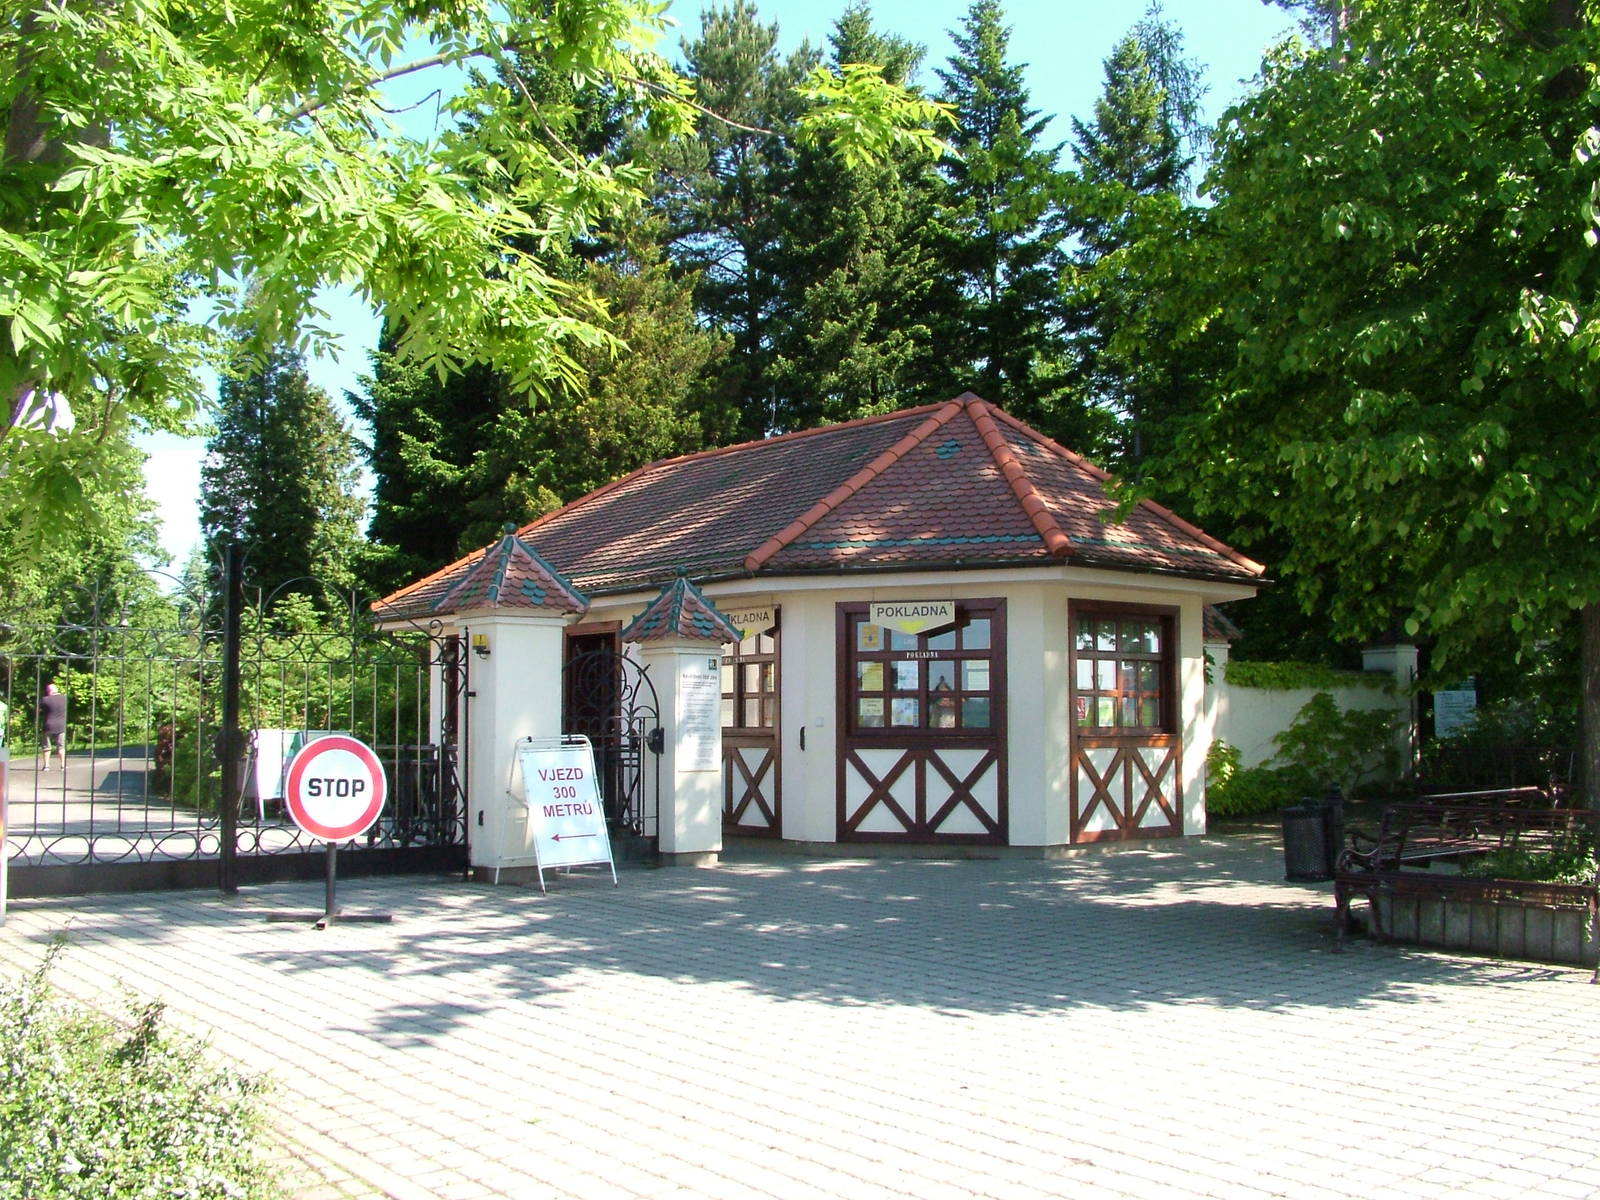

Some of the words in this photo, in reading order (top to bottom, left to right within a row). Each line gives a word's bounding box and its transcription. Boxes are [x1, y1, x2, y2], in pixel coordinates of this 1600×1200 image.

[728, 611, 770, 625] KLADNA
[877, 606, 948, 617] POKLADNA
[538, 767, 584, 782] VJEZD
[308, 778, 365, 797] STOP
[553, 786, 577, 799] 300
